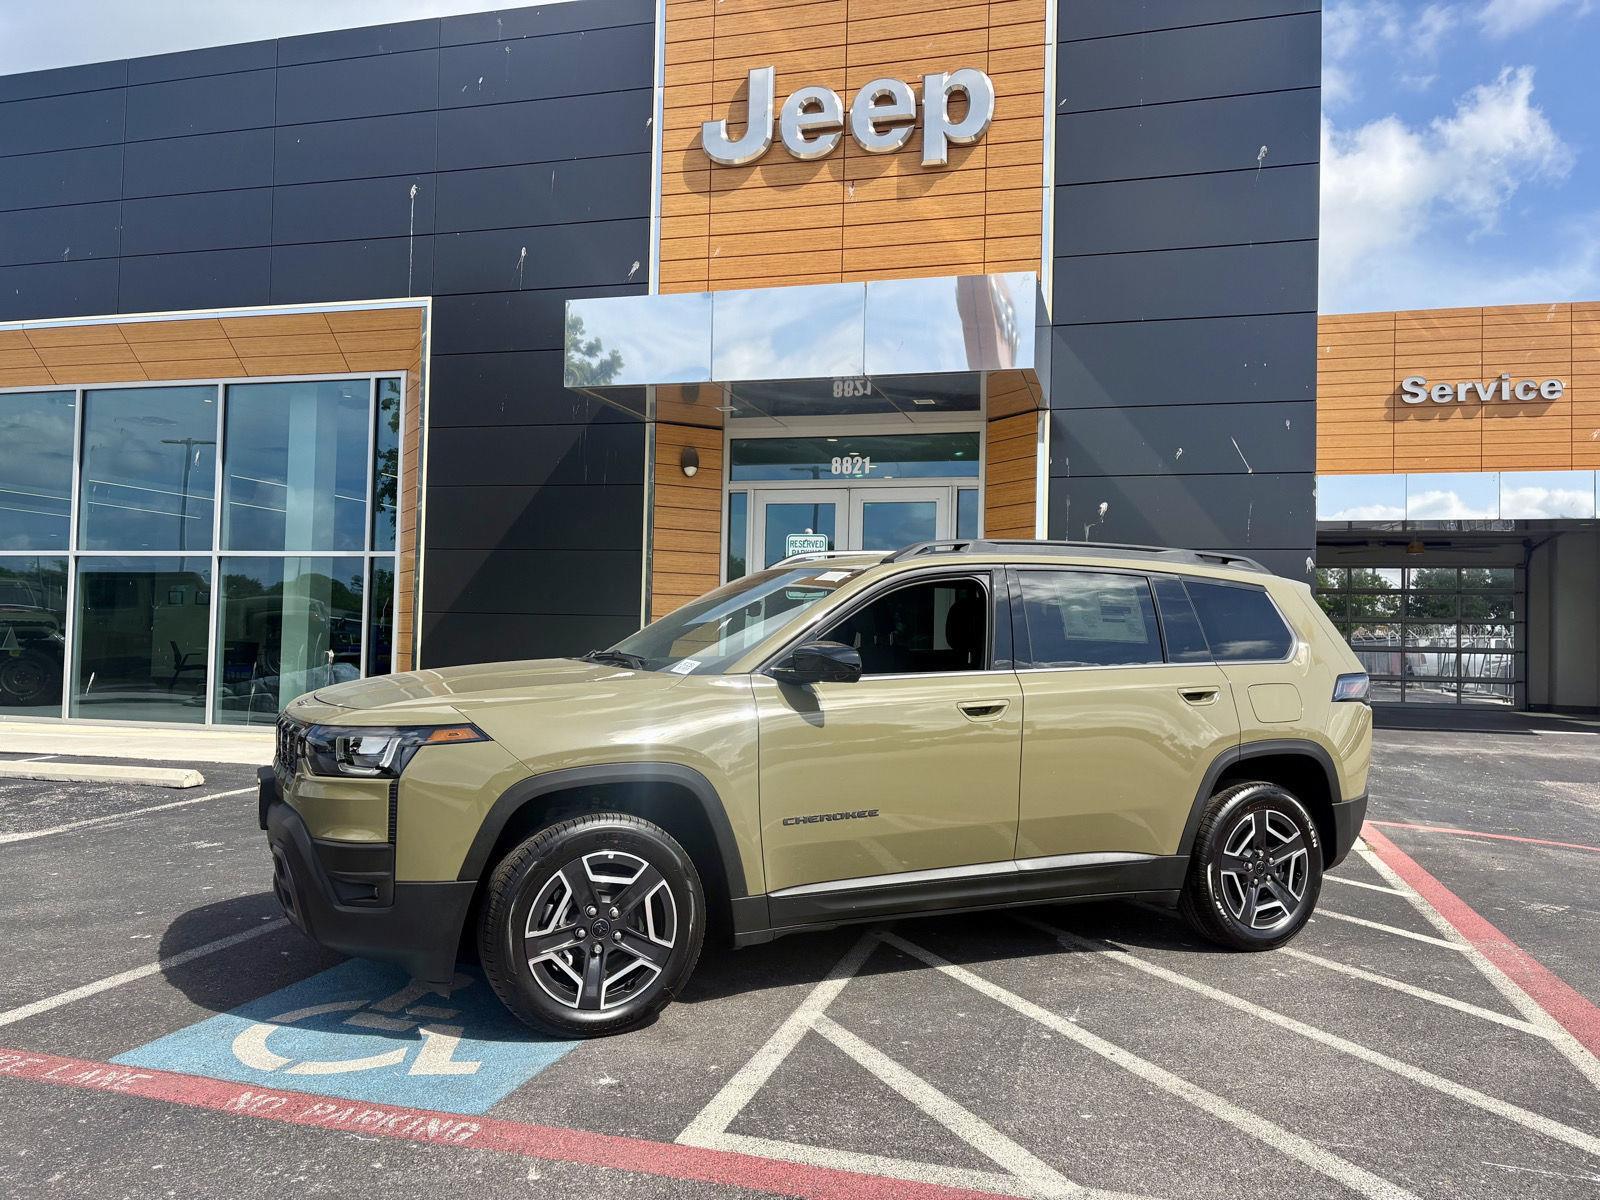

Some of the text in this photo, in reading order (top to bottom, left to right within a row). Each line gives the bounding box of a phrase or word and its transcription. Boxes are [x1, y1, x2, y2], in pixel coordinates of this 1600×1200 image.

[700, 65, 996, 168] Jeep
[1401, 373, 1563, 404] Service
[831, 456, 871, 474] 8821
[789, 539, 825, 549] RESERVED
[782, 808, 880, 827] CHEROKEE
[41, 1063, 154, 1090] LANE
[222, 1091, 482, 1143] NO PARKING
